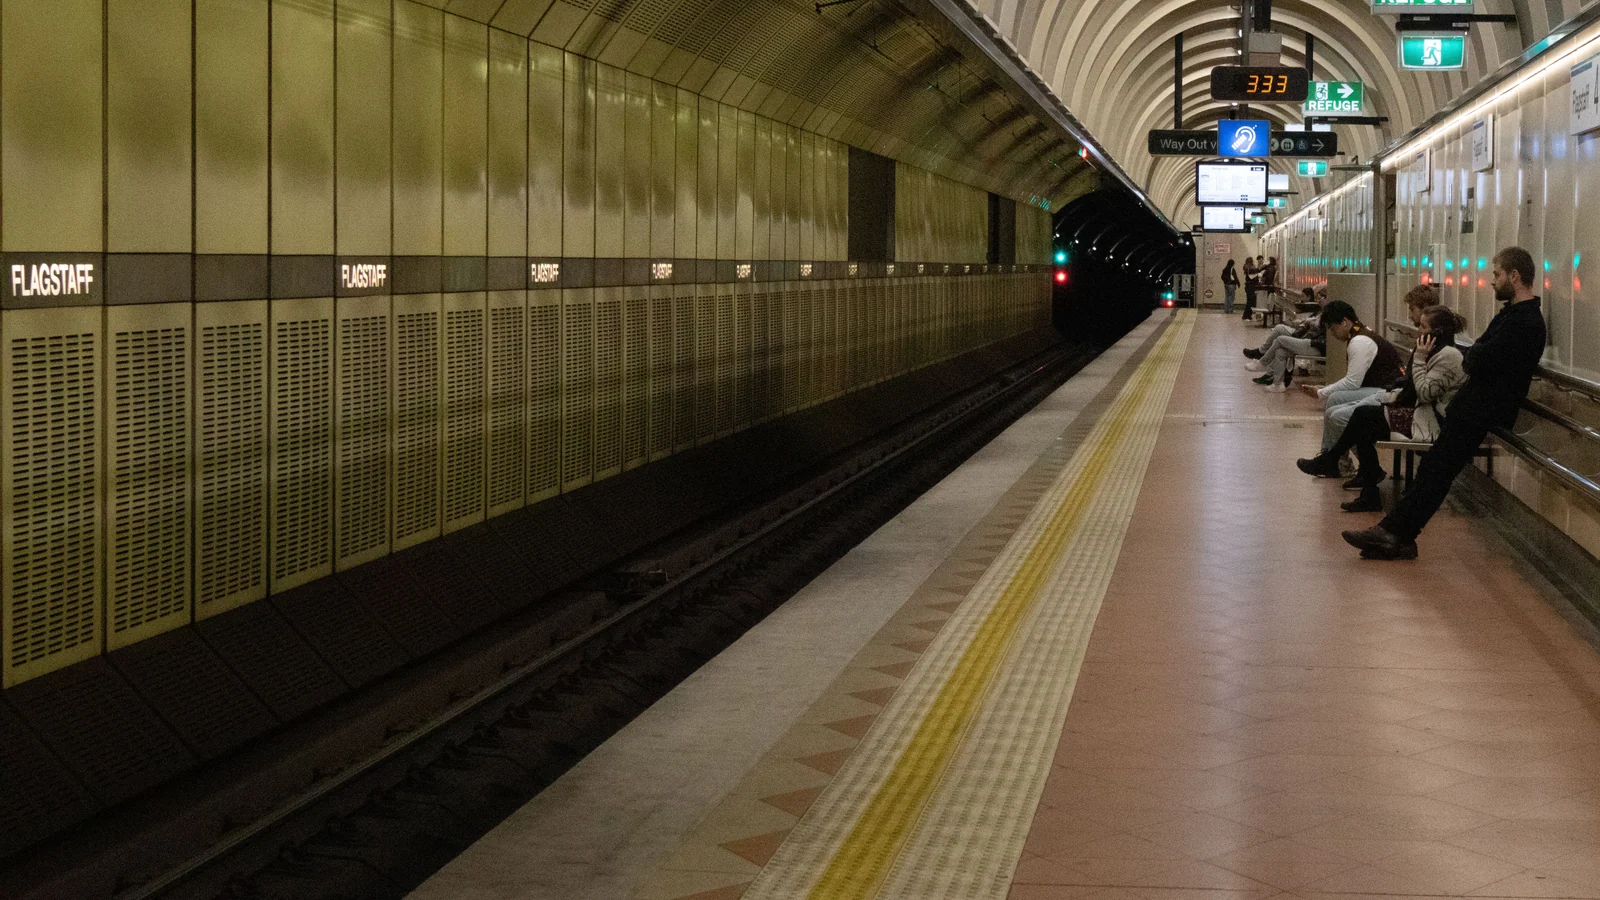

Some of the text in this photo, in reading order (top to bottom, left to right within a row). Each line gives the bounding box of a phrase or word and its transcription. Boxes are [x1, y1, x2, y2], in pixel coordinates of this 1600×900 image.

[1308, 100, 1360, 111] REFUGE
[1160, 139, 1218, 152] Way Out v
[12, 263, 94, 296] FLAGSTAFF
[342, 263, 387, 288] FLAGSTAFF
[531, 263, 559, 282] FLAGSTAFF
